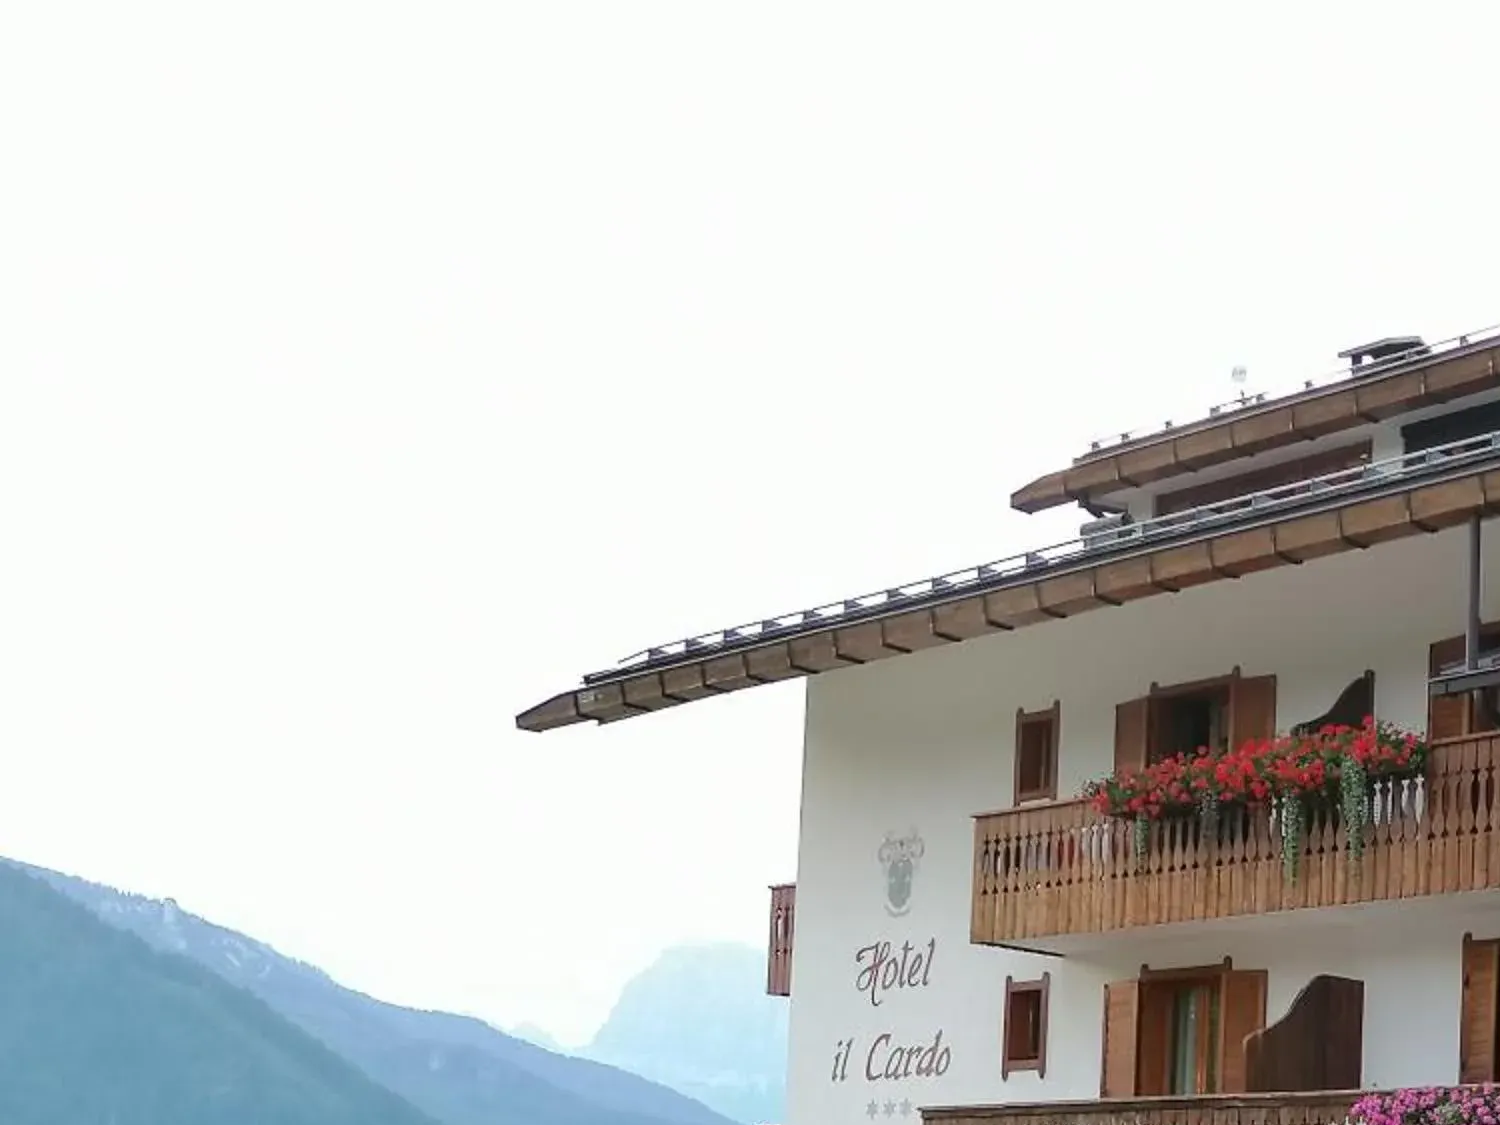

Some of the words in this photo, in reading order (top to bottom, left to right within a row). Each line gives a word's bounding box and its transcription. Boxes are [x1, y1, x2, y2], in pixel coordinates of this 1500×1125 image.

[856, 937, 935, 1006] Hotel
[831, 1037, 854, 1082] il
[865, 1028, 951, 1081] Cardo
